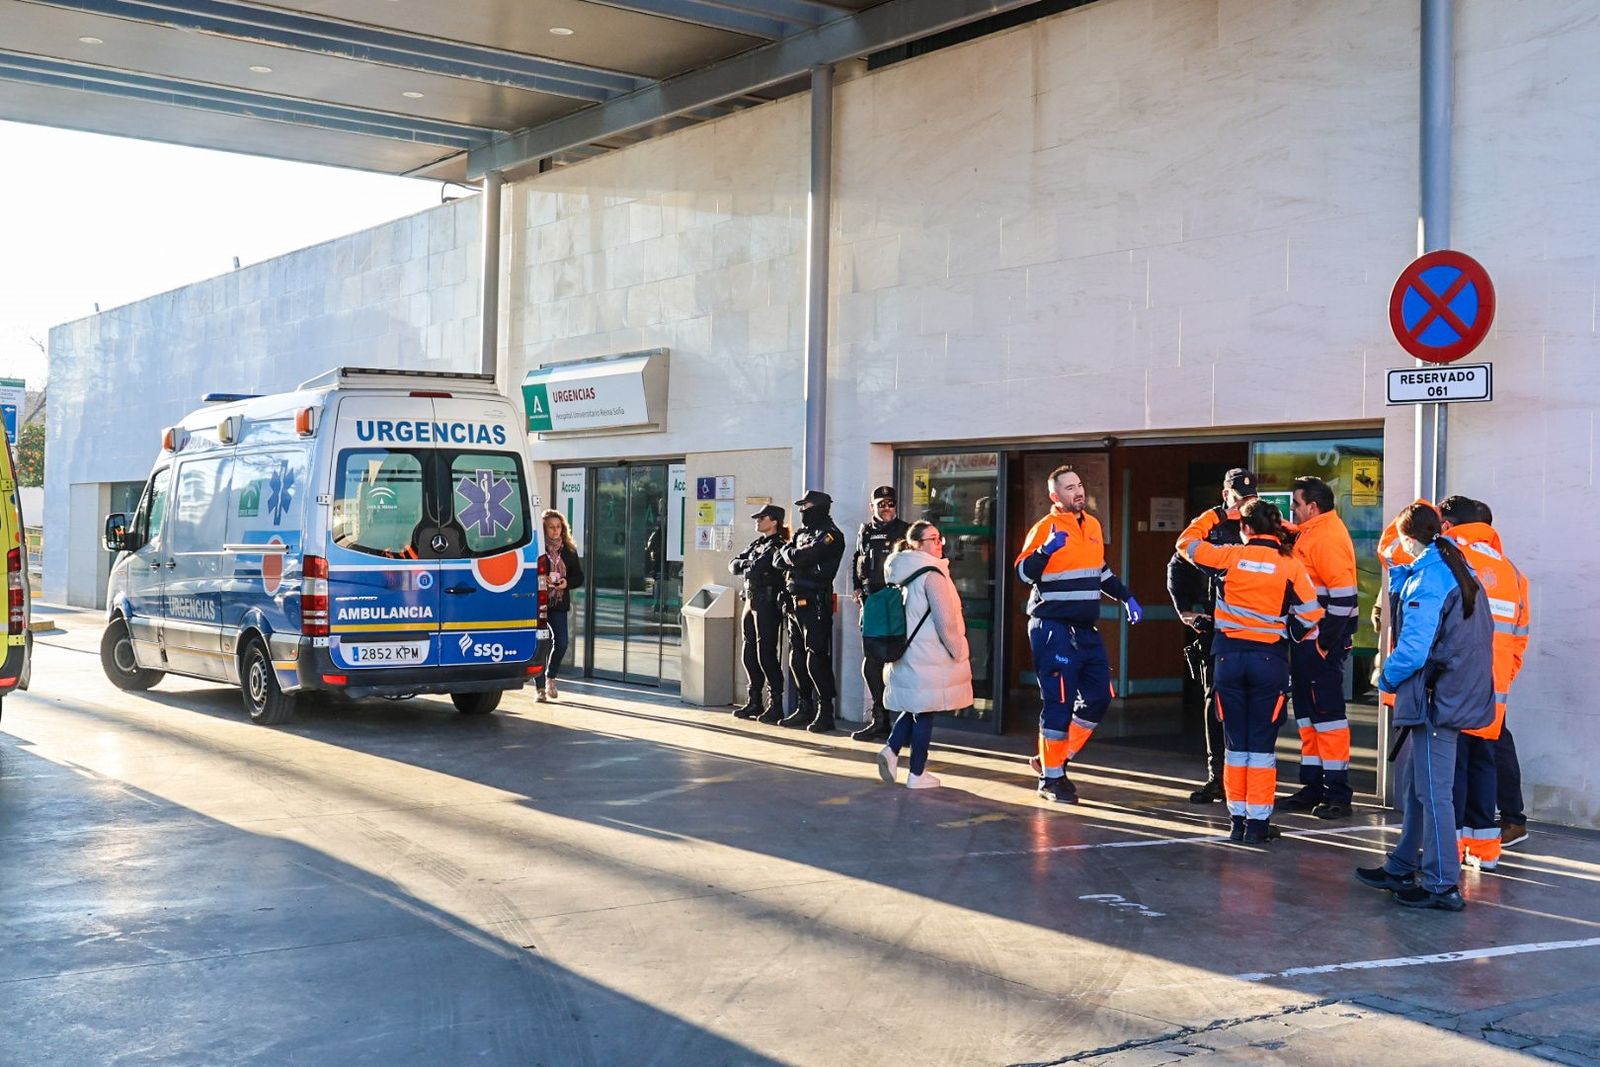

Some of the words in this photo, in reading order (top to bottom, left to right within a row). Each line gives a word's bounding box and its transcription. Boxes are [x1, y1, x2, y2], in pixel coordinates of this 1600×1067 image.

[1400, 371, 1475, 384] RESERVADO
[552, 387, 596, 403] URGENCIAS
[1427, 386, 1448, 397] 061
[356, 420, 506, 445] URGENCIAS
[561, 481, 581, 493] Acceso
[168, 596, 216, 620] URGENCIAS
[337, 606, 433, 620] AMBULANCIA
[361, 648, 392, 660] 2852
[396, 647, 419, 659] KPM
